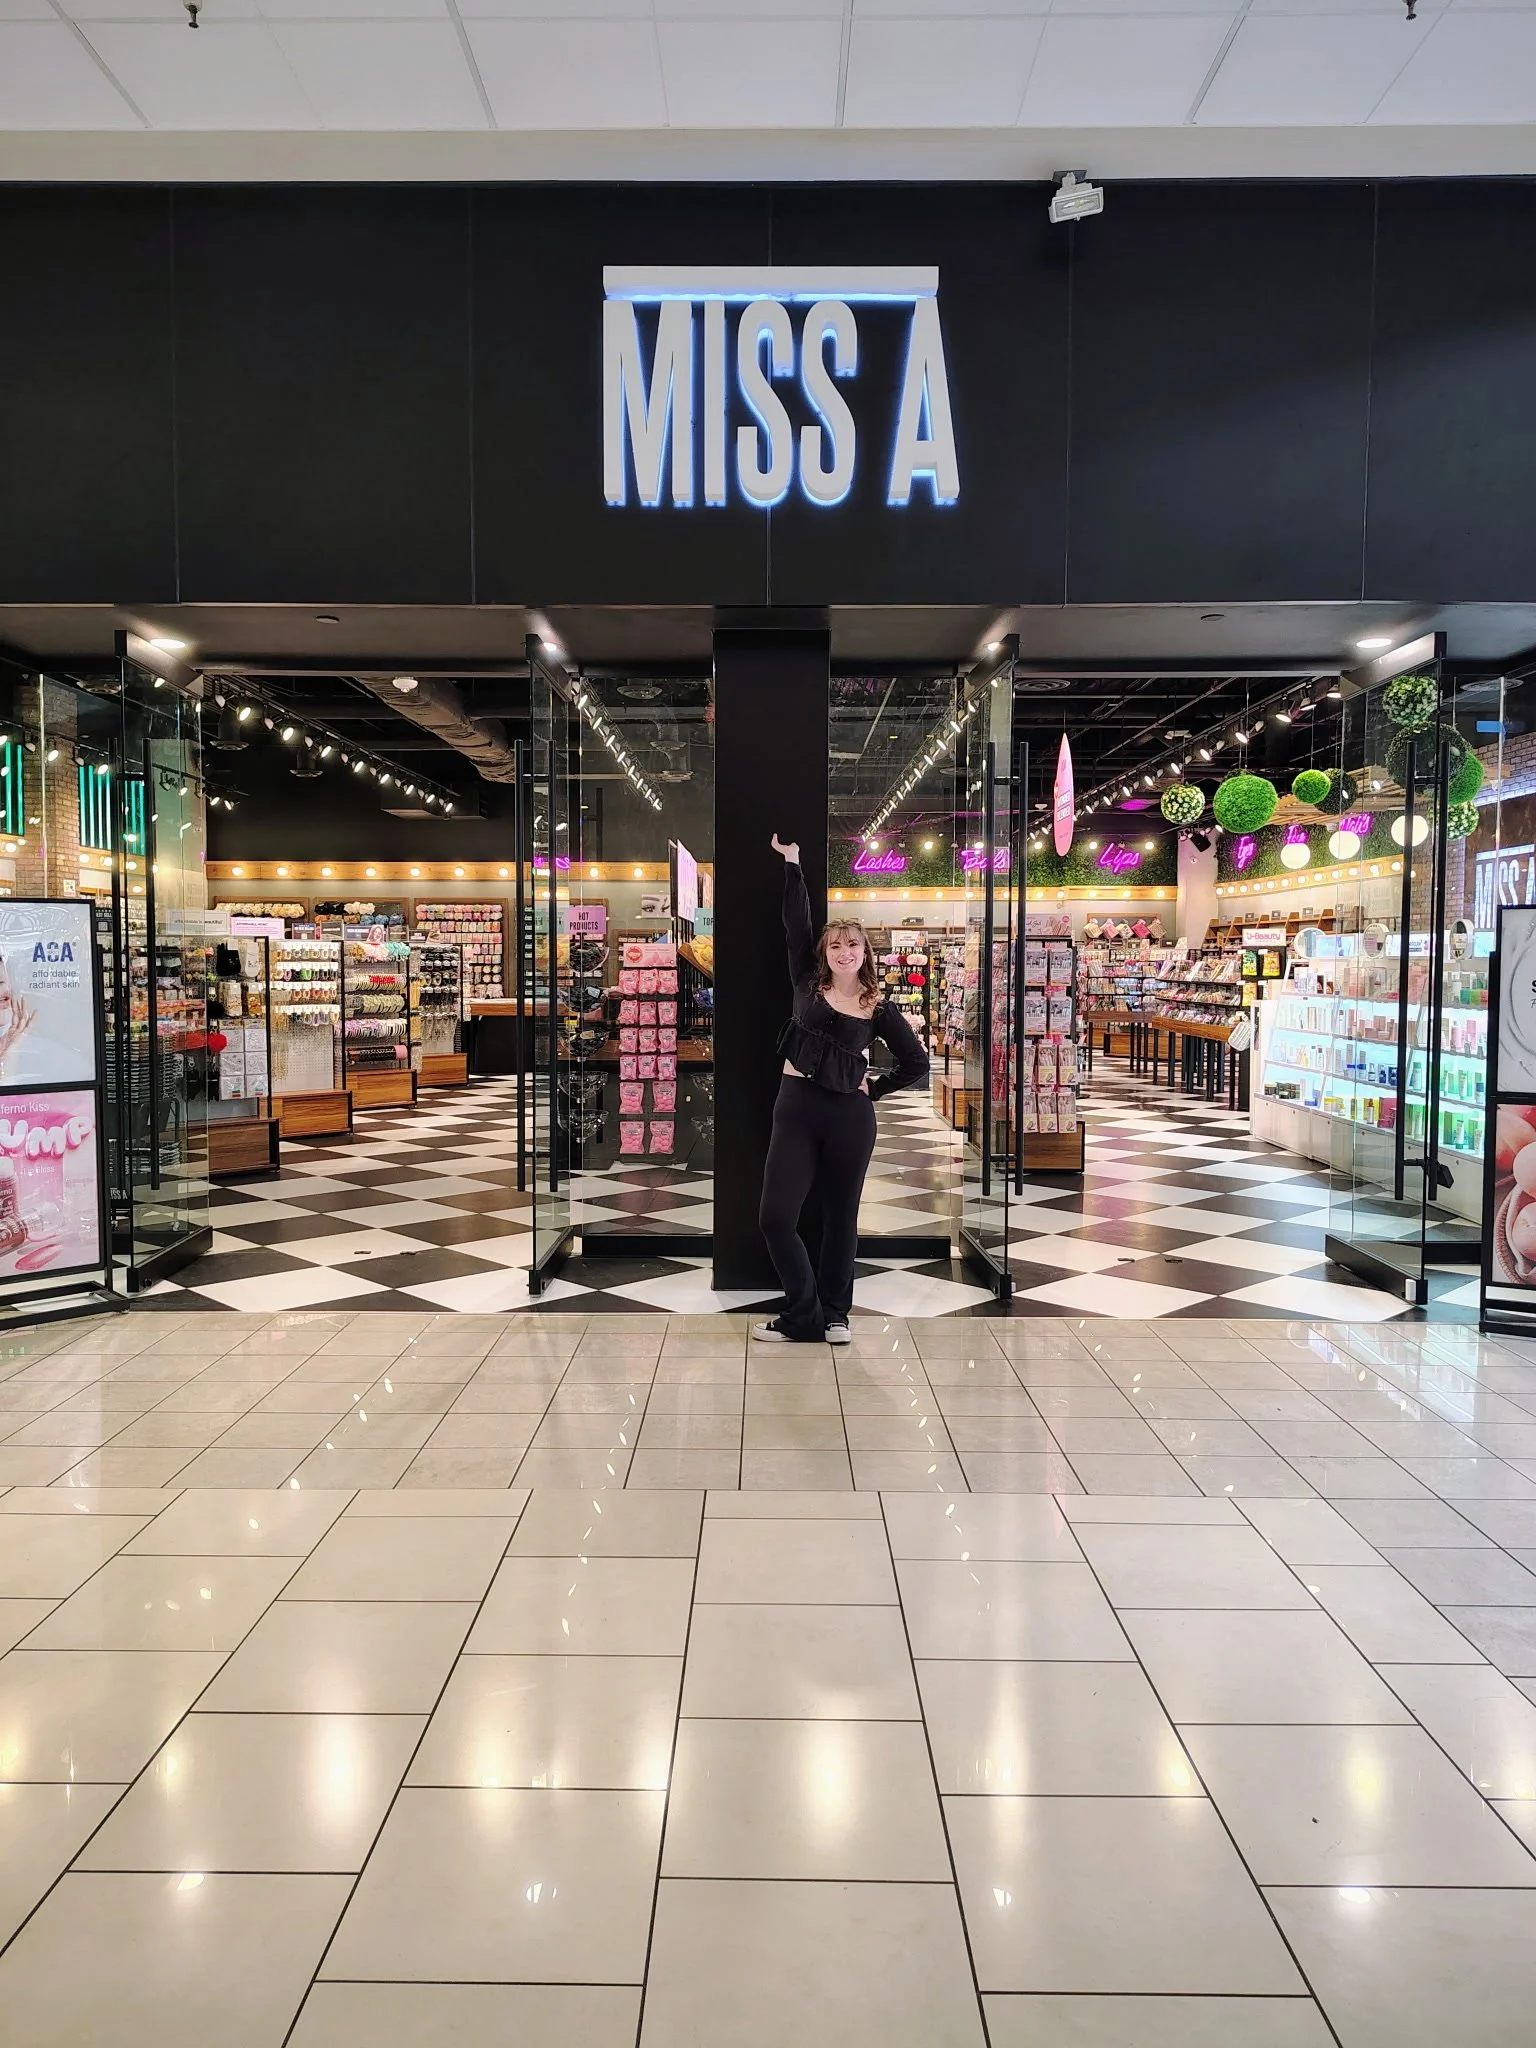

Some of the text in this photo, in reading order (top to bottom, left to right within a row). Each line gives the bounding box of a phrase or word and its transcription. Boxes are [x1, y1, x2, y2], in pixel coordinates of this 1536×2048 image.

[603, 297, 961, 506] MISS A
[853, 849, 906, 871] Lashes
[1099, 843, 1140, 874] Lips
[578, 911, 590, 921] HOT
[569, 921, 599, 931] PRODUCTS
[1246, 932, 1281, 941] J-Beauty
[29, 980, 80, 989] radiant skin
[29, 1102, 50, 1113] Kiss
